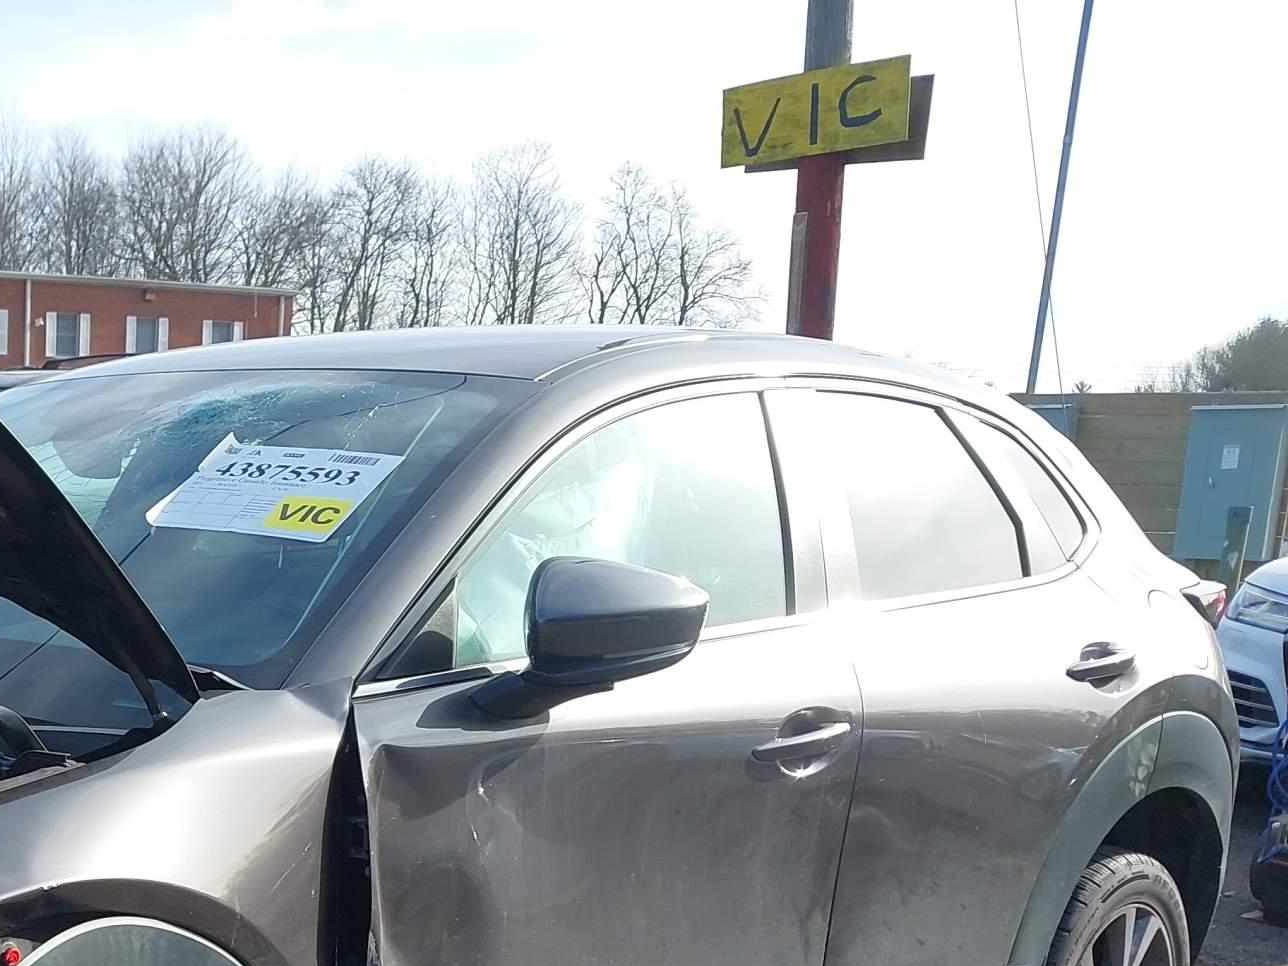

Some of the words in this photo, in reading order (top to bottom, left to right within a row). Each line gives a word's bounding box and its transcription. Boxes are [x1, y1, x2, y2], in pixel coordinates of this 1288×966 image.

[733, 75, 882, 157] VIC
[216, 461, 361, 486] 43875593
[278, 503, 341, 525] VIC
